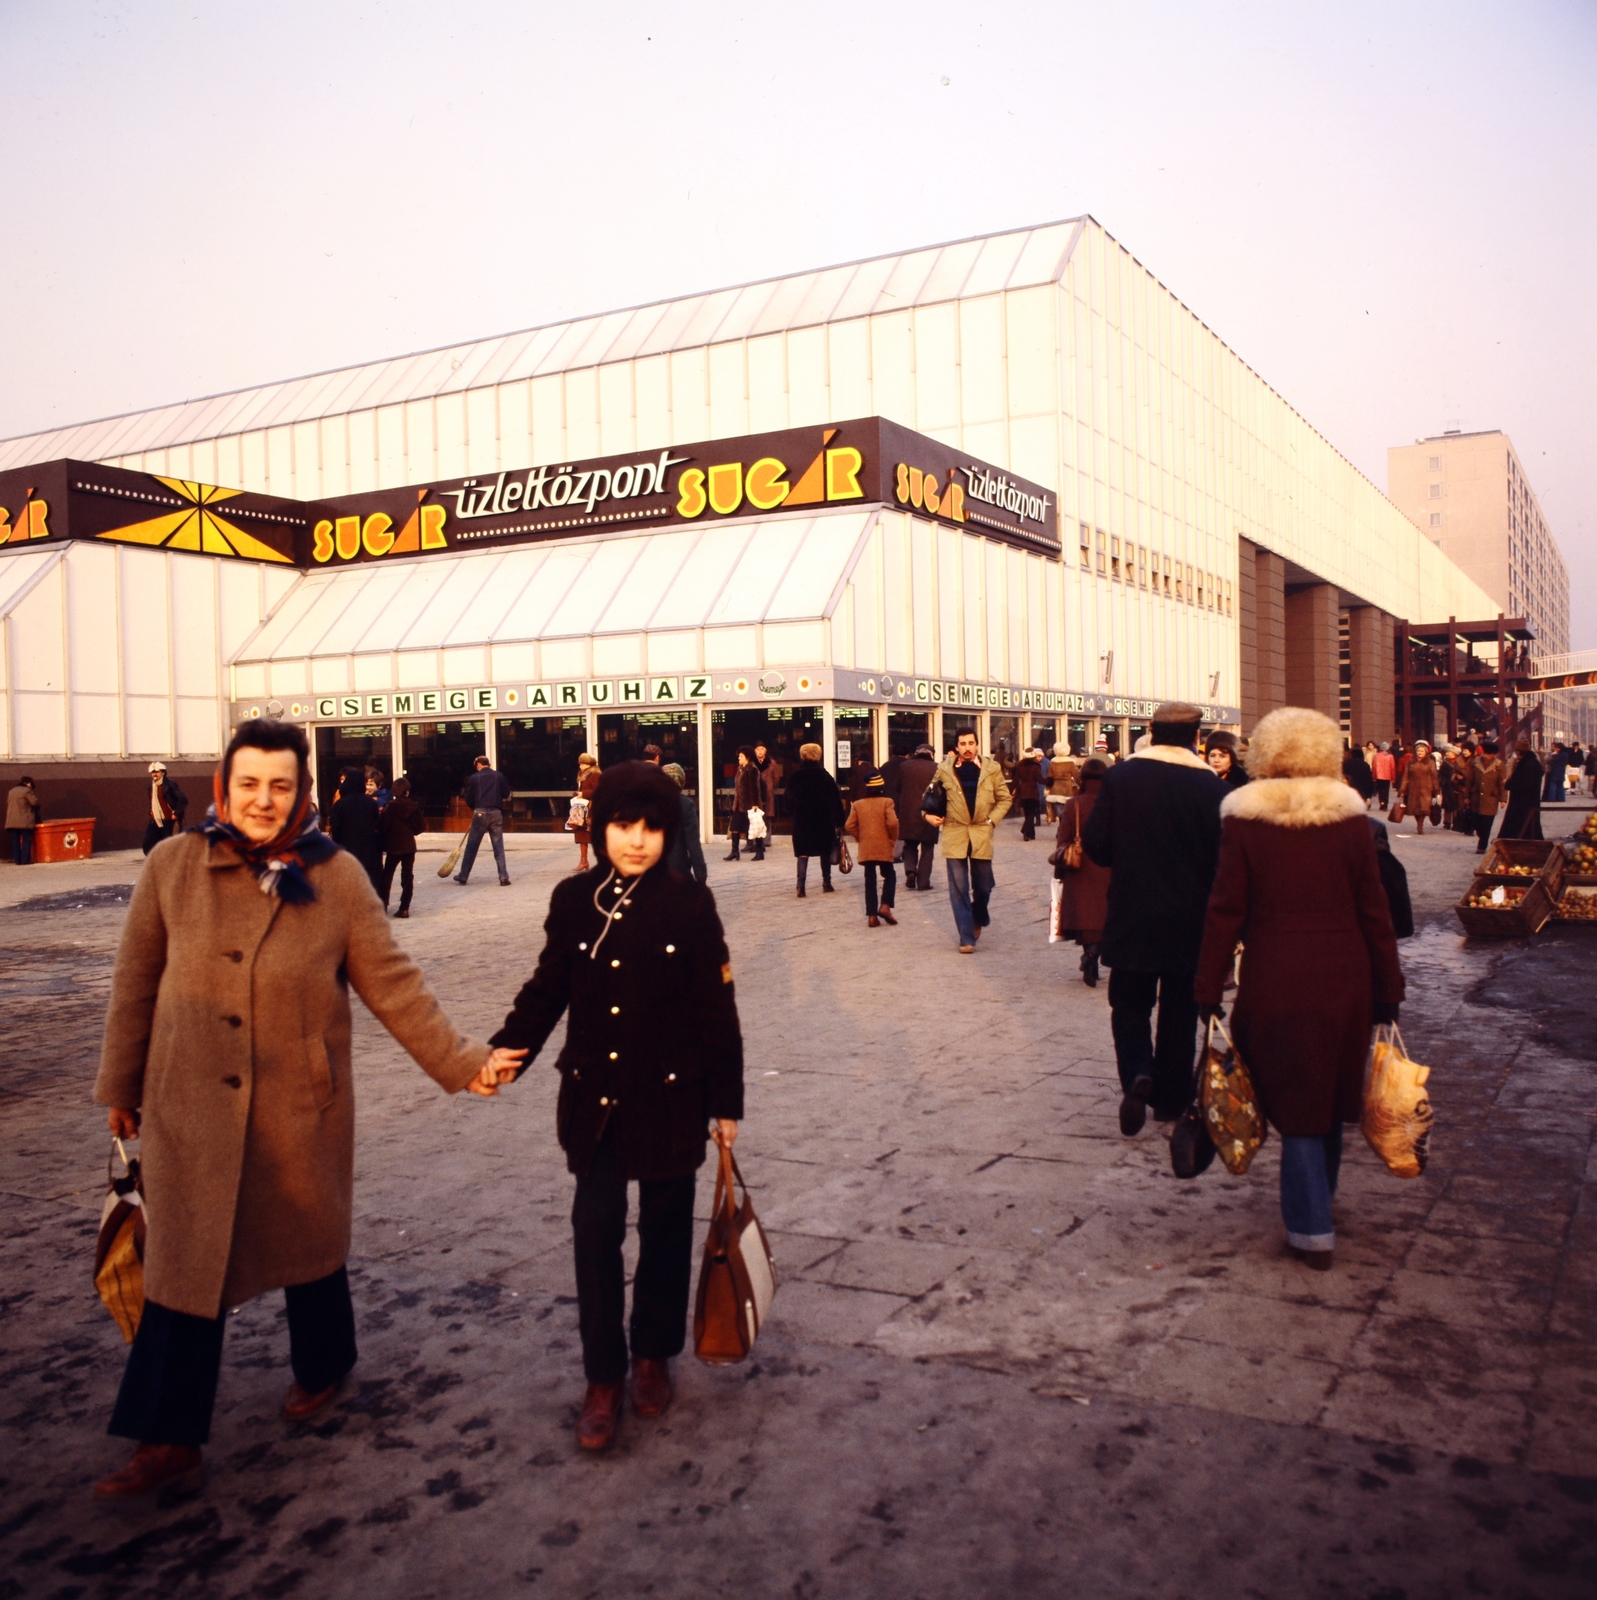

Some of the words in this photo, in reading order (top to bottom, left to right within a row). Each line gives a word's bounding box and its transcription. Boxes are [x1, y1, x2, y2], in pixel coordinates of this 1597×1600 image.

[312, 489, 448, 563] SUGÁR
[440, 450, 694, 519] üzletközpont
[676, 429, 864, 518] SUGÁR
[896, 463, 965, 523] SUGÁR
[958, 466, 1052, 524] üzletközpont
[319, 690, 492, 717] CSEMEGE
[917, 682, 1008, 706] CSEMEGE
[1115, 700, 1159, 716] CSEME
